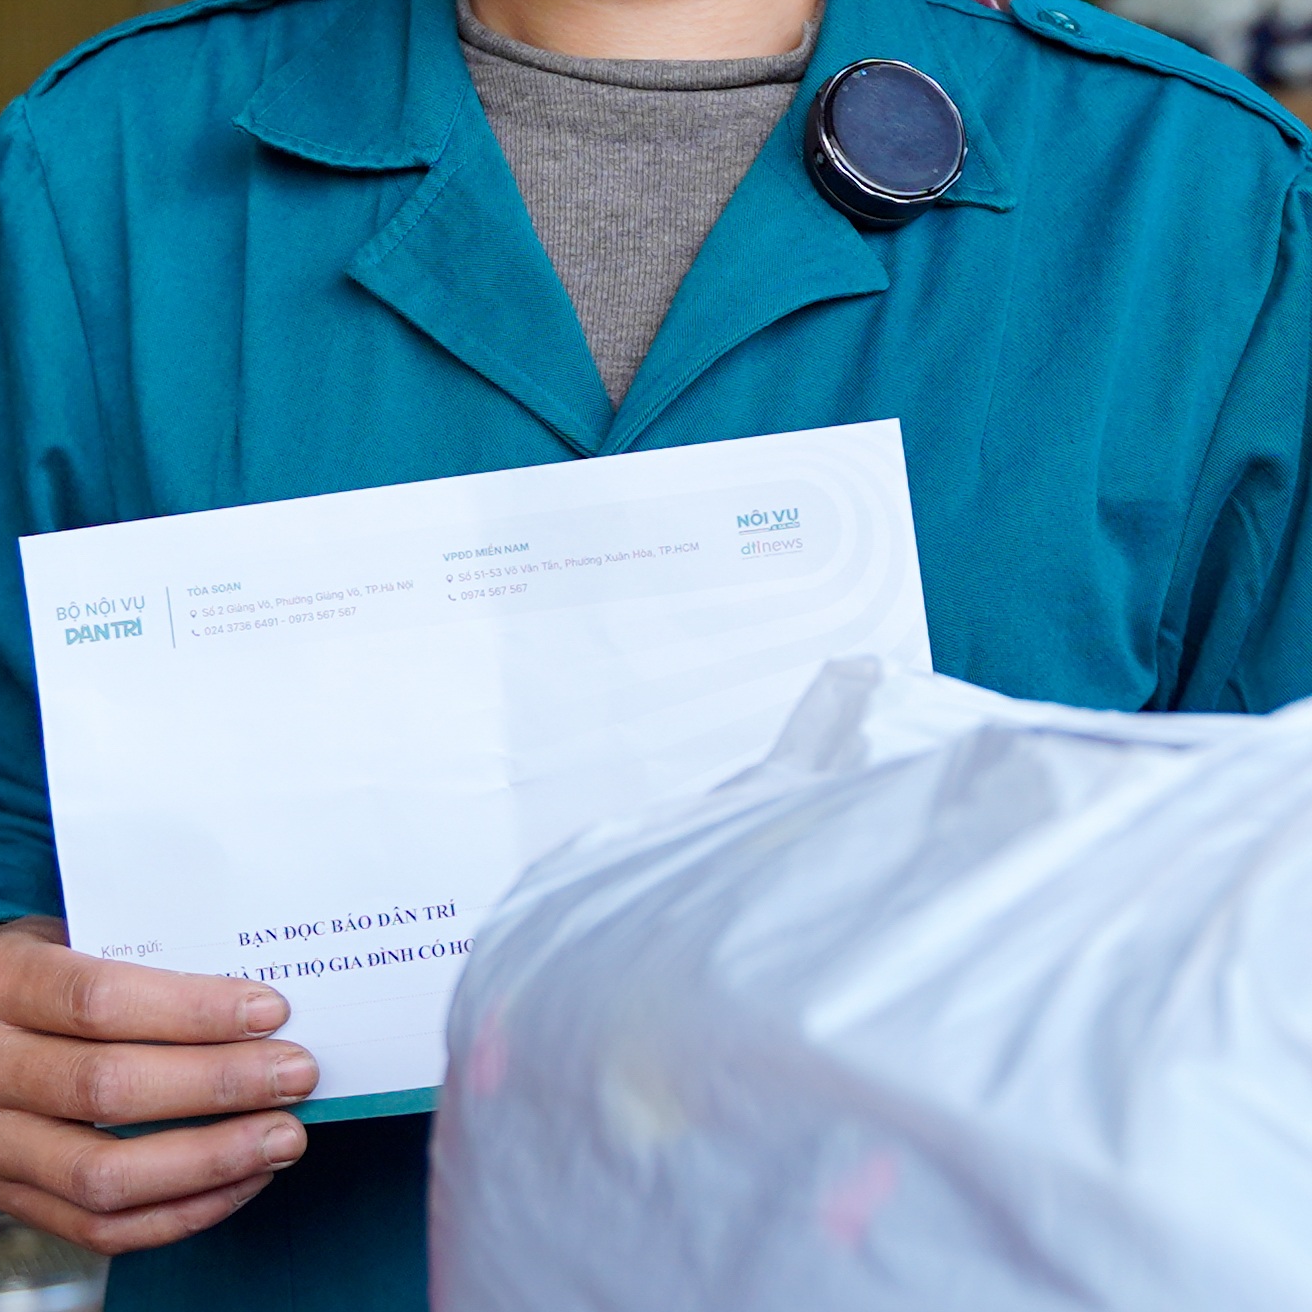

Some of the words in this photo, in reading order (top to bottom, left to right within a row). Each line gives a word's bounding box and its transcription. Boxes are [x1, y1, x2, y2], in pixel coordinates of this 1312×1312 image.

[442, 550, 474, 562] VPĐD
[504, 542, 530, 555] NAM
[458, 570, 472, 582] Số
[474, 567, 503, 580] 51-53
[657, 542, 700, 557] TP.HCM
[187, 585, 209, 599] TÒA
[211, 581, 242, 595] SOẠN
[461, 588, 486, 601] 0974
[488, 585, 508, 598] 567
[509, 582, 529, 596] 567
[56, 601, 81, 623] BỘ
[85, 596, 116, 618] NỘI
[120, 595, 145, 613] VỤ
[202, 606, 216, 618] Số
[218, 605, 225, 617] 2
[204, 625, 225, 637] 024
[226, 621, 251, 634] 3736
[253, 617, 279, 631] 6491
[288, 612, 315, 625] 0973
[317, 609, 336, 621] 567
[337, 606, 357, 619] 567
[238, 927, 279, 948] BẠN
[284, 921, 325, 941] ĐỌC
[331, 913, 372, 934] BÁO
[378, 906, 418, 929] DÂN
[422, 899, 457, 922] TRÍ
[100, 944, 134, 959] Kính
[255, 961, 292, 982] TẾT
[296, 957, 325, 979] HỘ
[329, 956, 364, 973] GIA
[367, 946, 414, 969] ĐÌNH
[418, 939, 446, 961] CÓ
